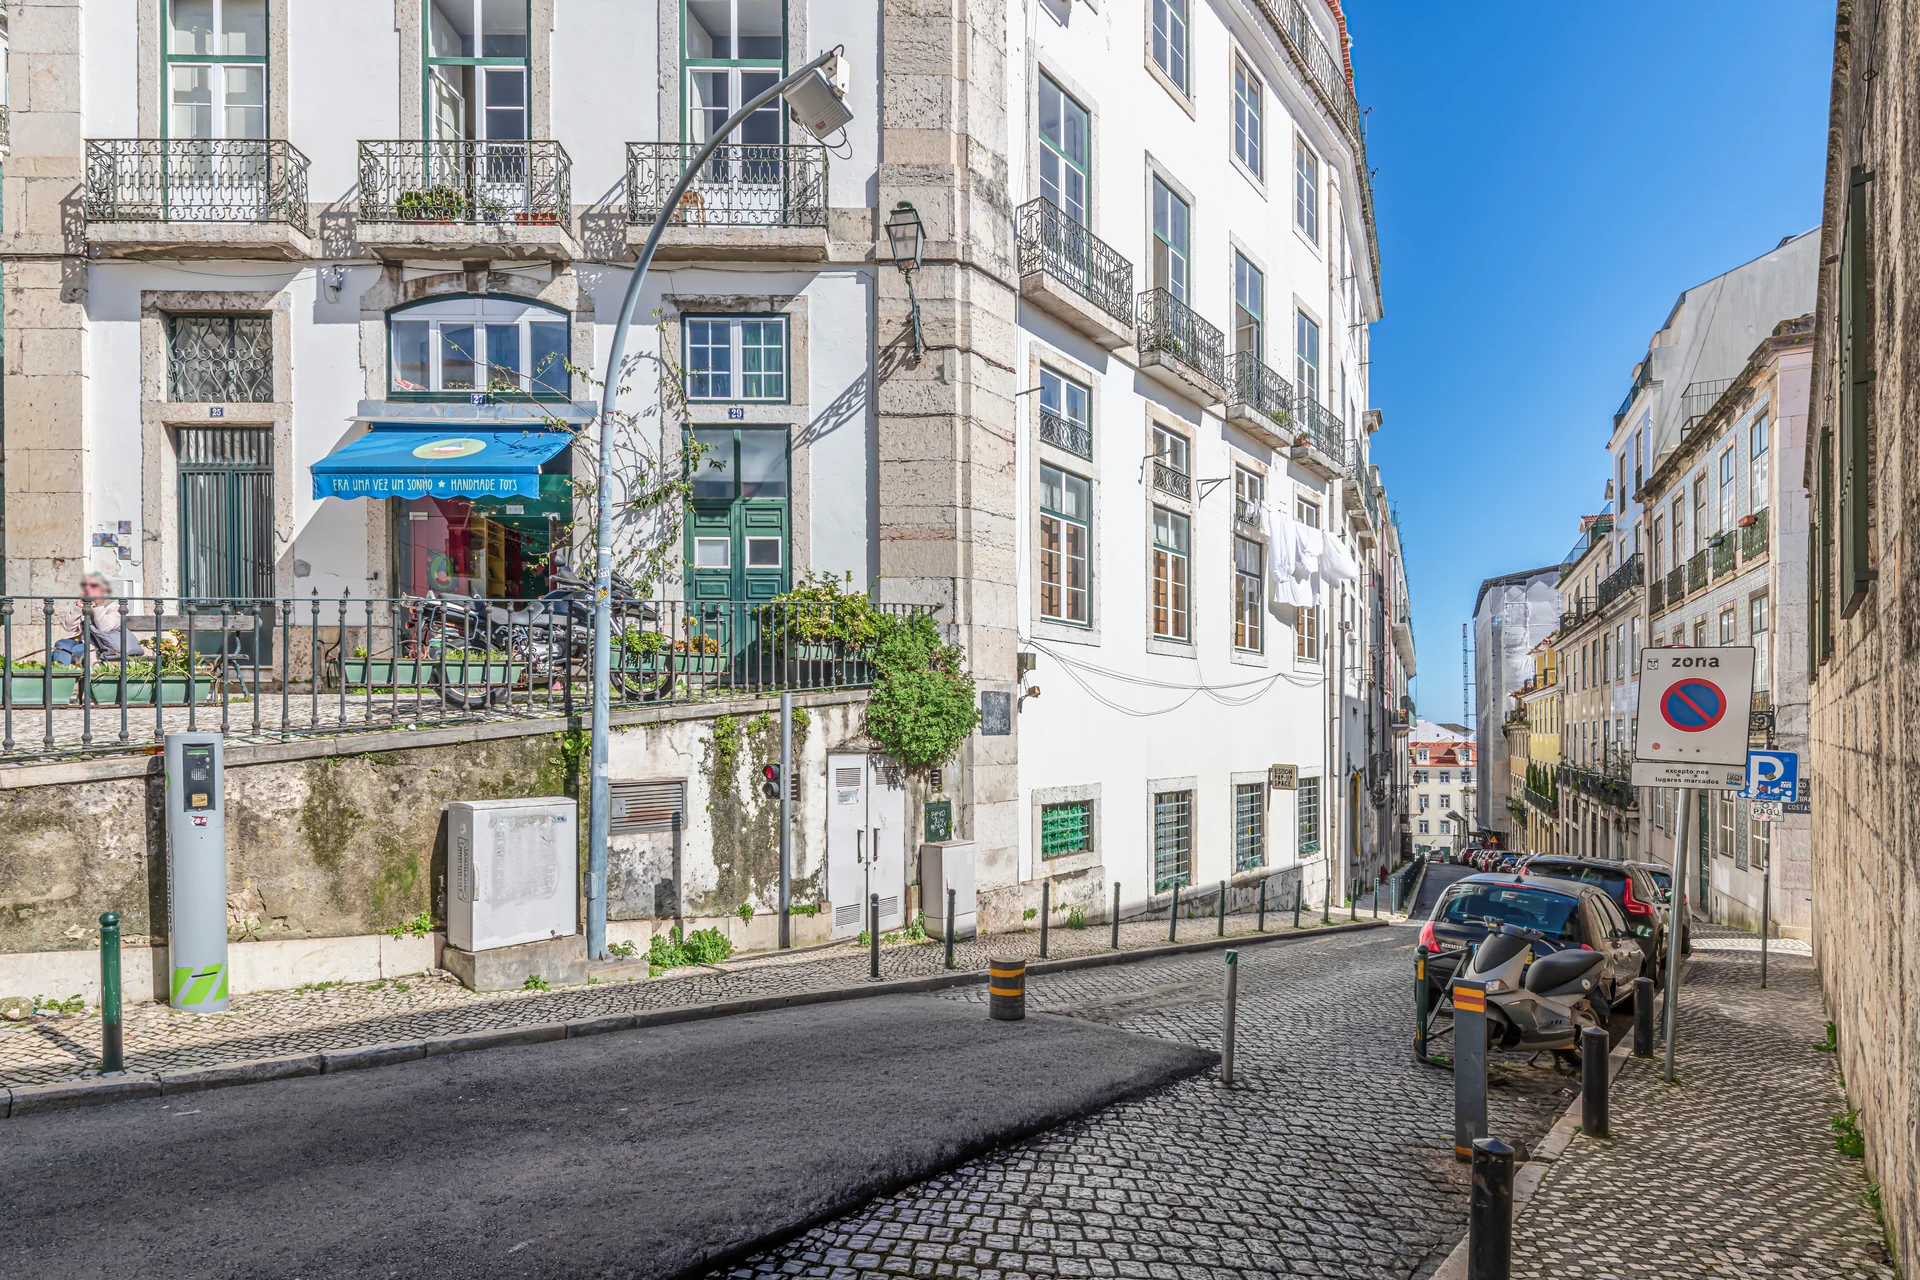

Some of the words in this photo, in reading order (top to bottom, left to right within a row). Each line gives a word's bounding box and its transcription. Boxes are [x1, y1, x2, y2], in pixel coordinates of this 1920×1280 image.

[473, 395, 484, 403] 27
[212, 408, 222, 416] 25
[731, 409, 742, 418] 29
[333, 479, 349, 491] ERA
[352, 479, 370, 490] UMA
[373, 479, 389, 490] VEZ
[391, 479, 404, 490] UM
[407, 479, 433, 491] SONHO
[451, 479, 495, 490] HANDMADE
[499, 479, 518, 491] TOYS
[1672, 656, 1720, 668] zona
[1749, 755, 1784, 795] P
